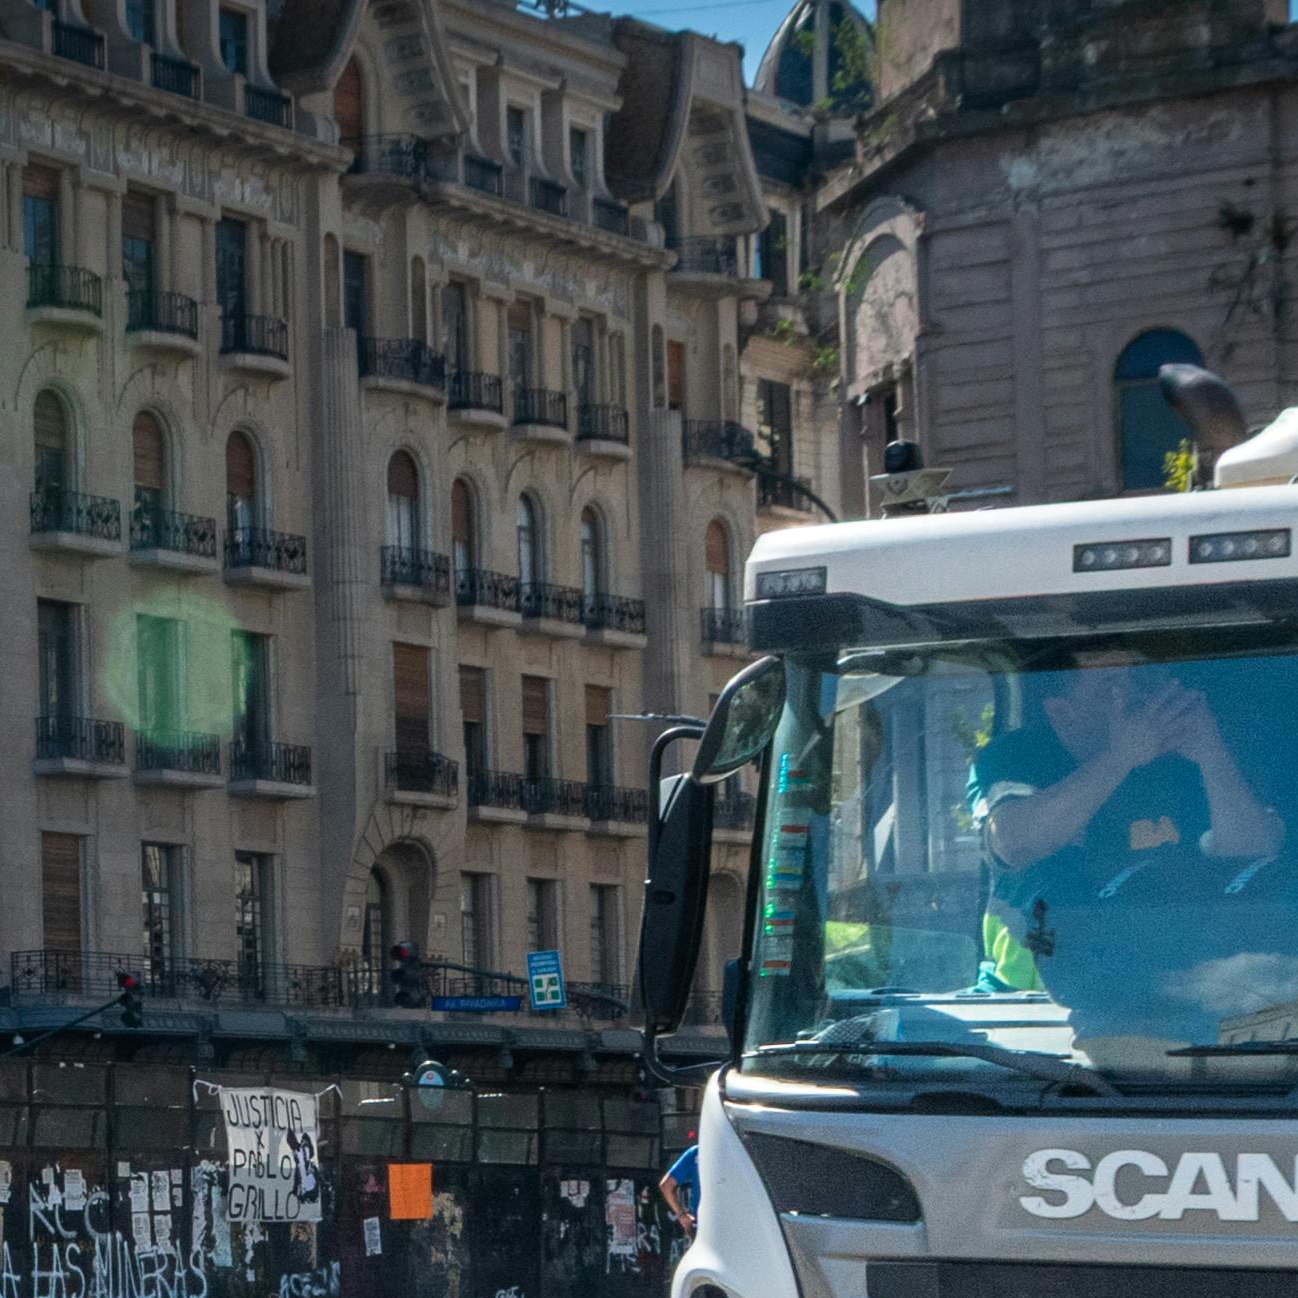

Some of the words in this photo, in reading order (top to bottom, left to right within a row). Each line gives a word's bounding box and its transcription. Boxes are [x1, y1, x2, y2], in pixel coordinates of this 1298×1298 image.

[227, 1093, 303, 1133] JUSTICIA
[233, 1148, 292, 1180] PABLO
[228, 1183, 301, 1220] GRILLO
